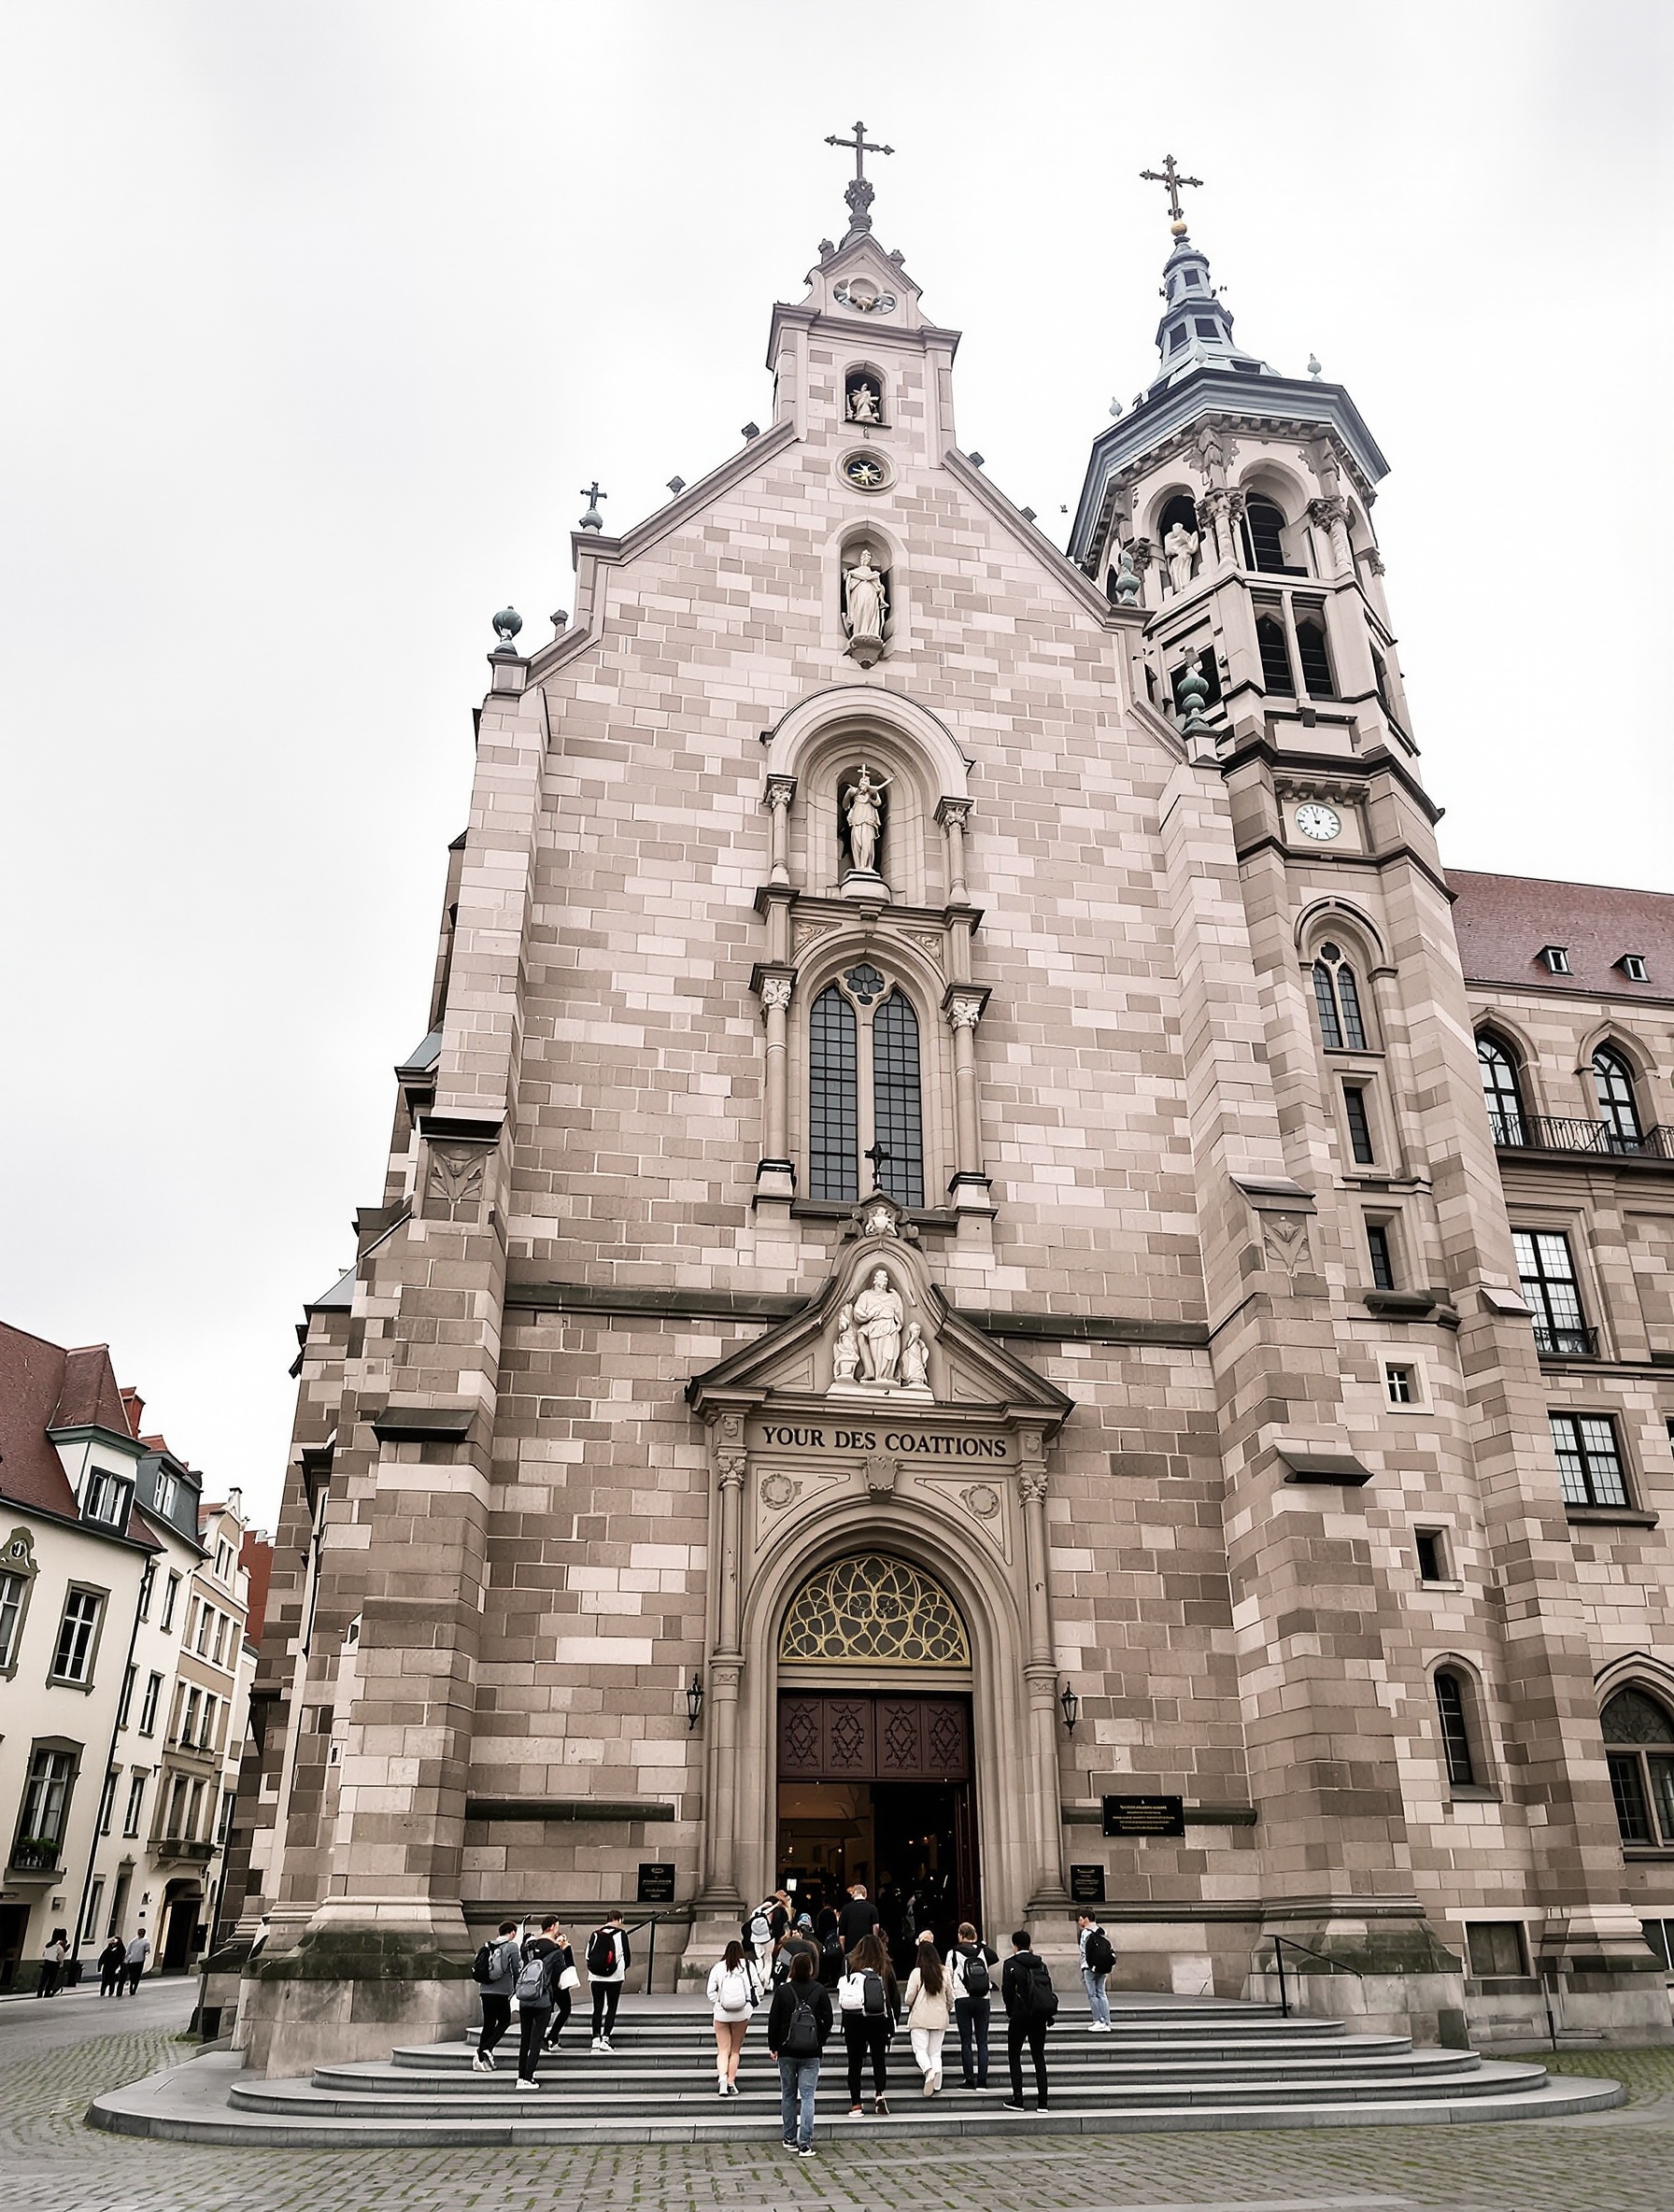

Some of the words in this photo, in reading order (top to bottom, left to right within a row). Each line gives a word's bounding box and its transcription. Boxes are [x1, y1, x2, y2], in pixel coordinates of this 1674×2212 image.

[762, 1426, 825, 1447] YOUR
[834, 1430, 876, 1450] DES
[884, 1433, 1007, 1457] COATTIONS
